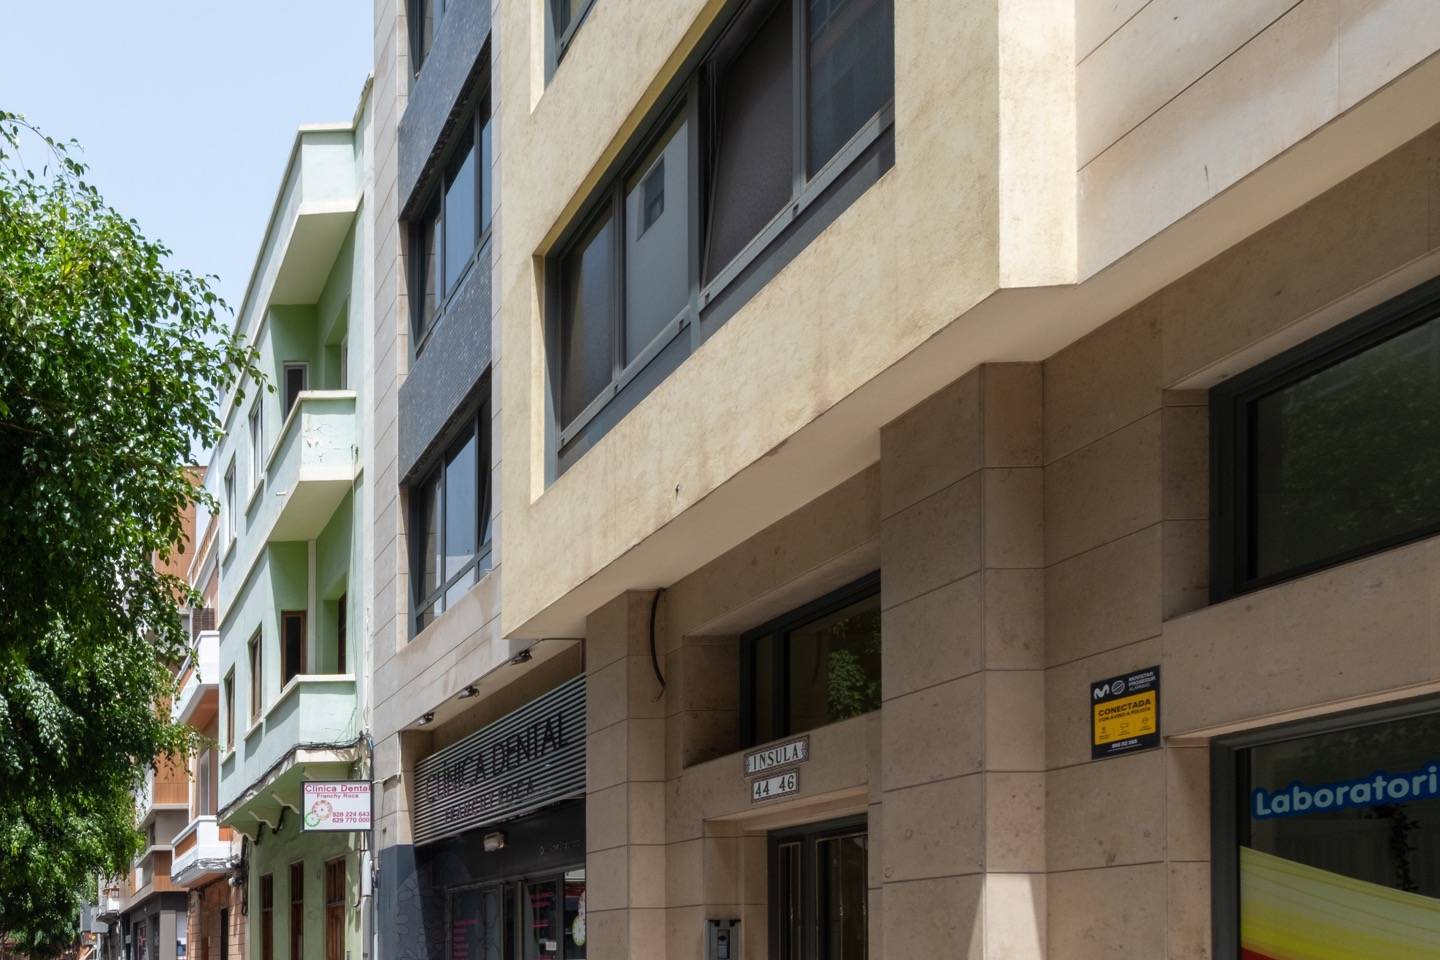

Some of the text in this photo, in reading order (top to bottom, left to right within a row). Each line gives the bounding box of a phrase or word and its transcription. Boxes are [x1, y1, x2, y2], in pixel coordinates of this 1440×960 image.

[1097, 698, 1151, 717] CONECTADA
[492, 712, 570, 777] DENTAL
[753, 744, 799, 770] INSULA
[341, 784, 371, 792] Dental
[755, 775, 794, 797] 44 46
[1256, 765, 1438, 816] Laboratori
